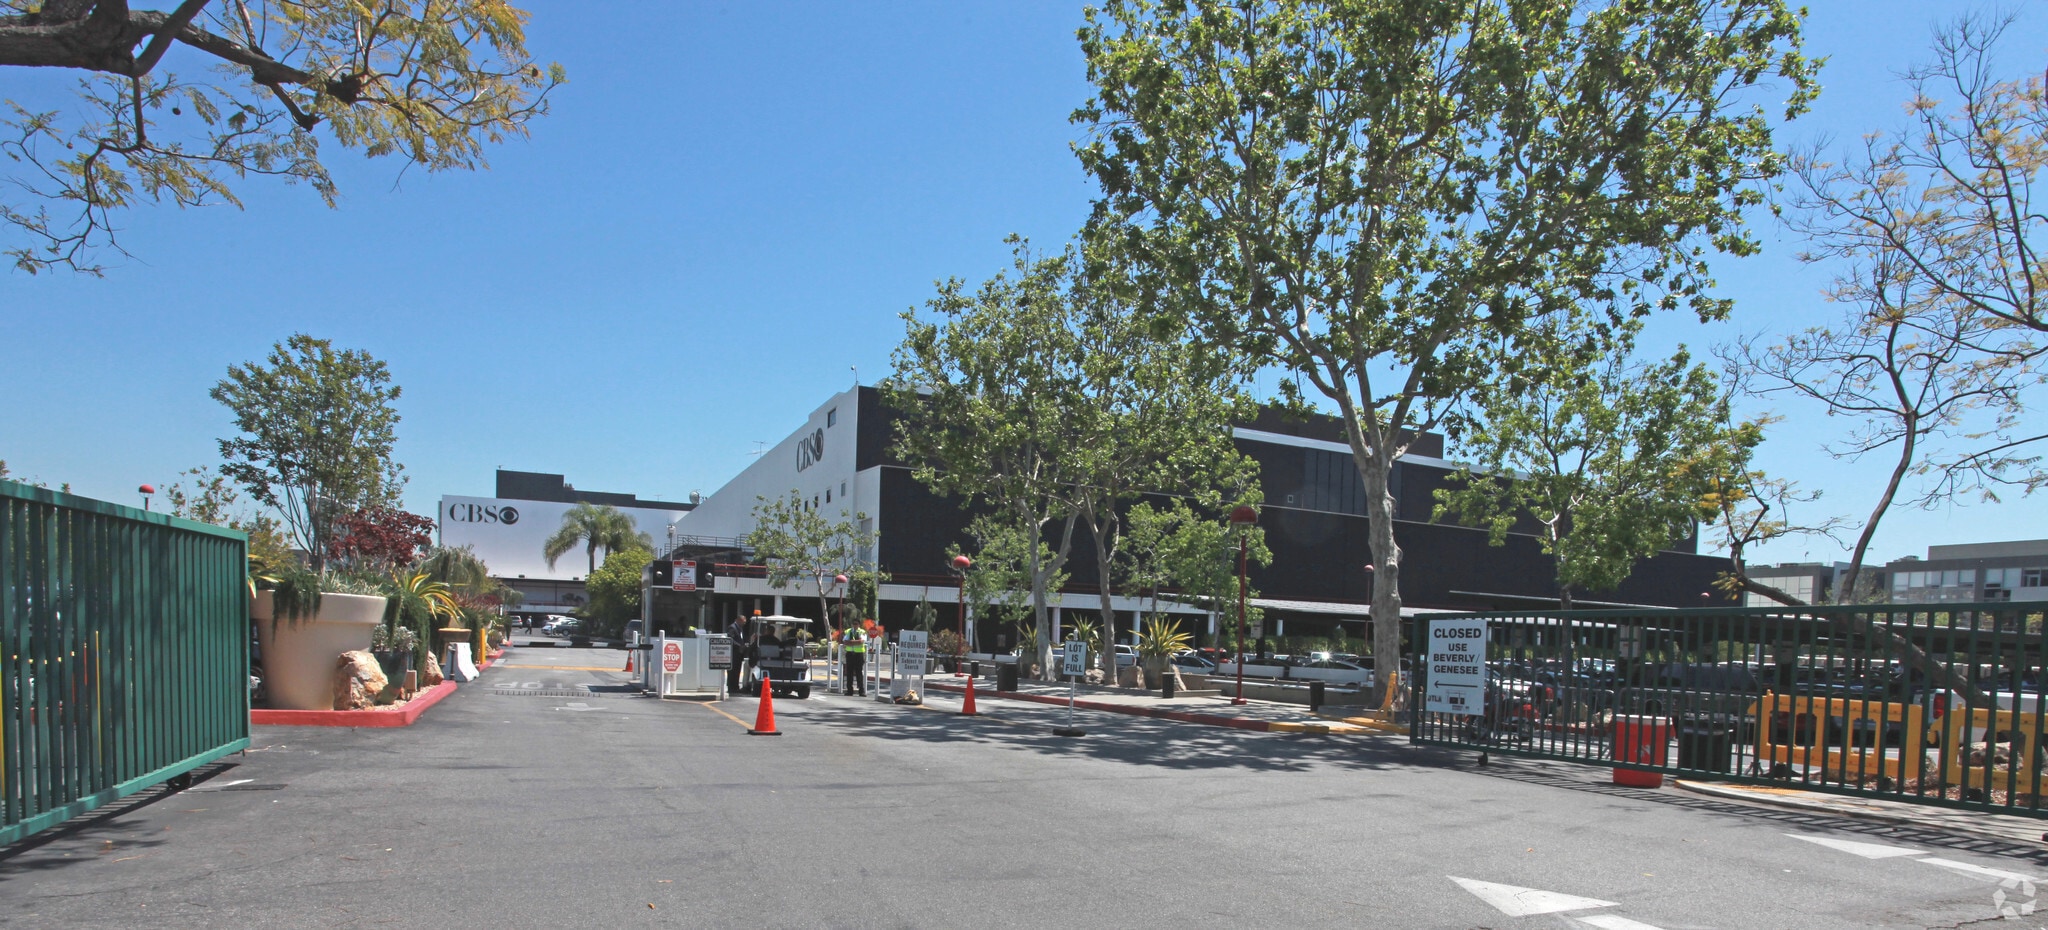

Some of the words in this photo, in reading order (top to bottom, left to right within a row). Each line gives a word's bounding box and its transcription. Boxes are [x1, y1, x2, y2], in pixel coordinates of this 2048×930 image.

[796, 432, 815, 473] CBS
[449, 503, 498, 524] CBS
[1434, 628, 1482, 639] CLOSED
[900, 641, 926, 649] REQUIRED
[1069, 644, 1083, 652] LOT
[1448, 643, 1468, 652] USE
[663, 653, 680, 661] STOP
[1071, 654, 1079, 662] IS
[1433, 653, 1481, 664] BEVERLY/
[1065, 663, 1082, 672] FULL
[1433, 665, 1479, 675] GENESEE
